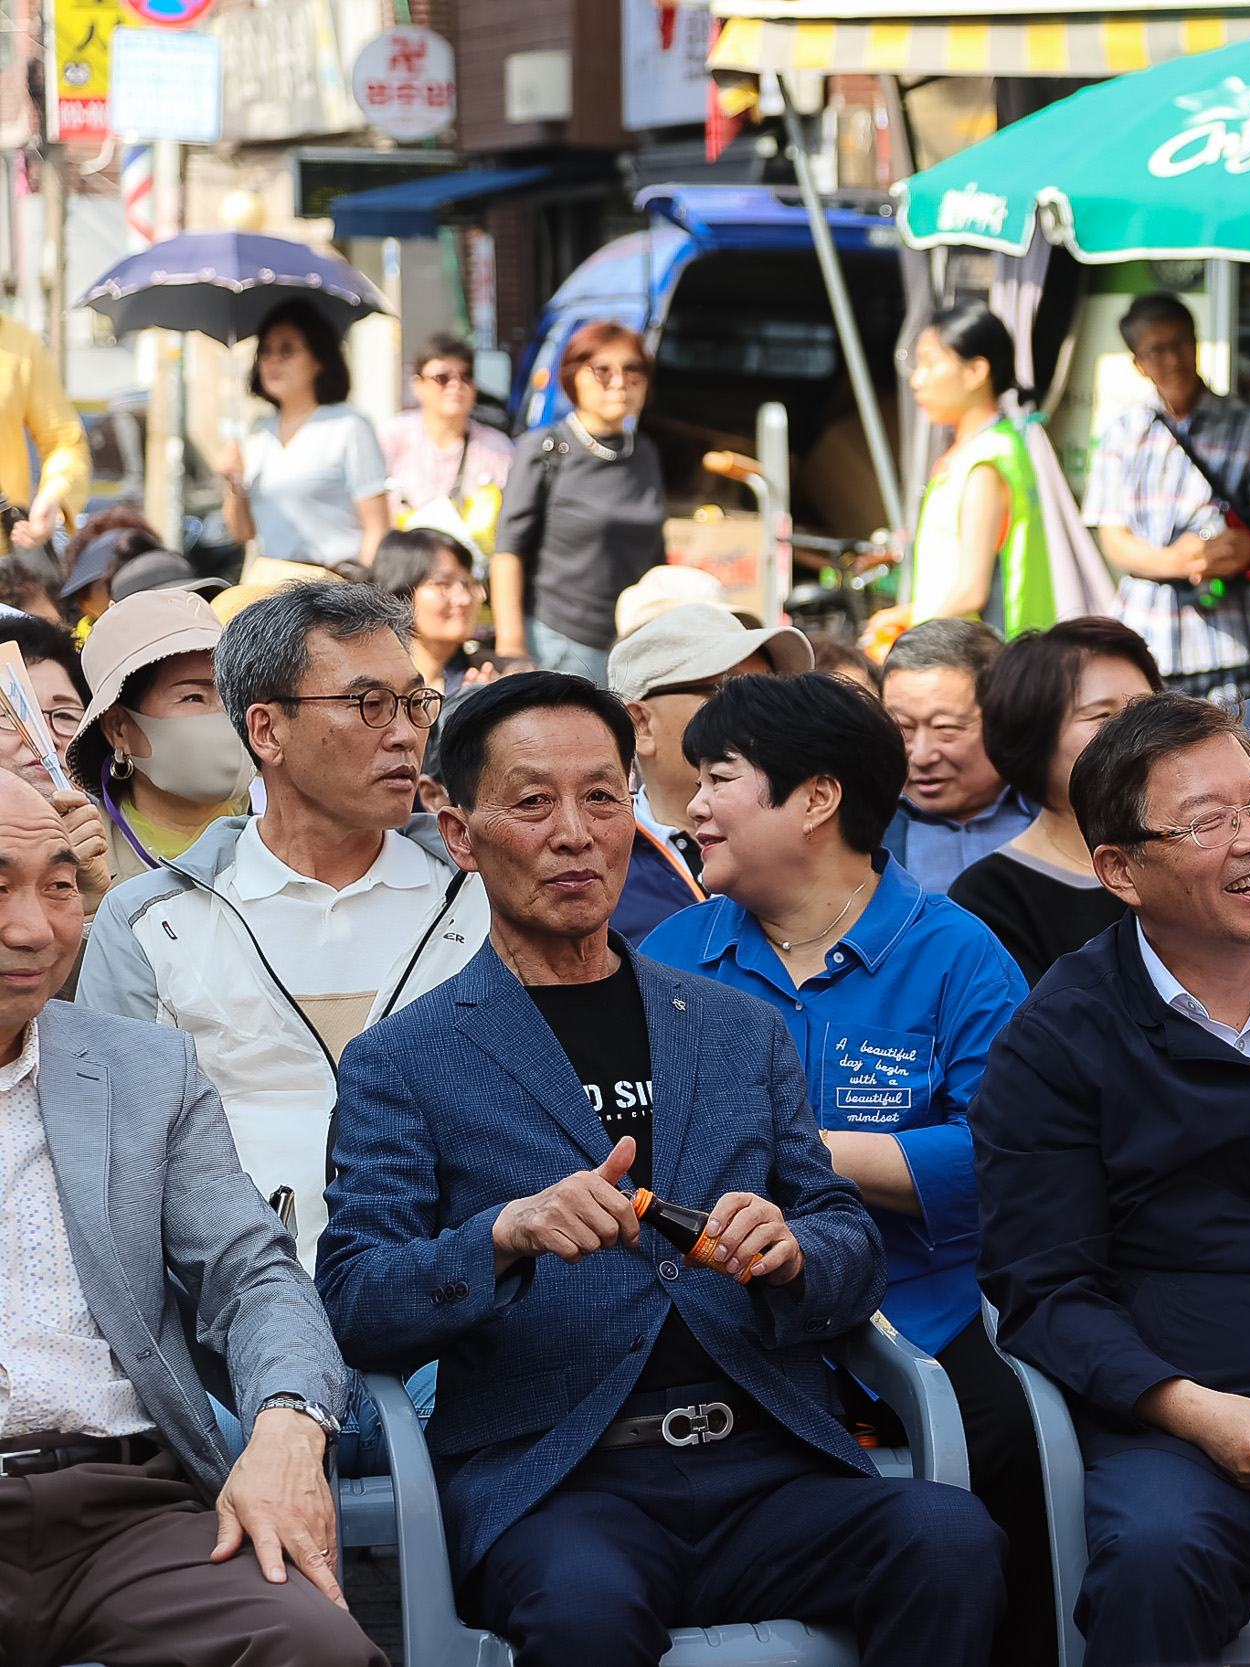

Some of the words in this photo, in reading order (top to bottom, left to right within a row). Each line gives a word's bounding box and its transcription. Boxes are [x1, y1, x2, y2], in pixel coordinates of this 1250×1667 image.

[835, 1037, 847, 1050] A
[860, 1039, 916, 1061] beautiful
[839, 1053, 862, 1071] day
[875, 1059, 909, 1075] begin
[849, 1073, 876, 1085] with
[845, 1090, 902, 1105] beautiful
[846, 1110, 899, 1122] mindset
